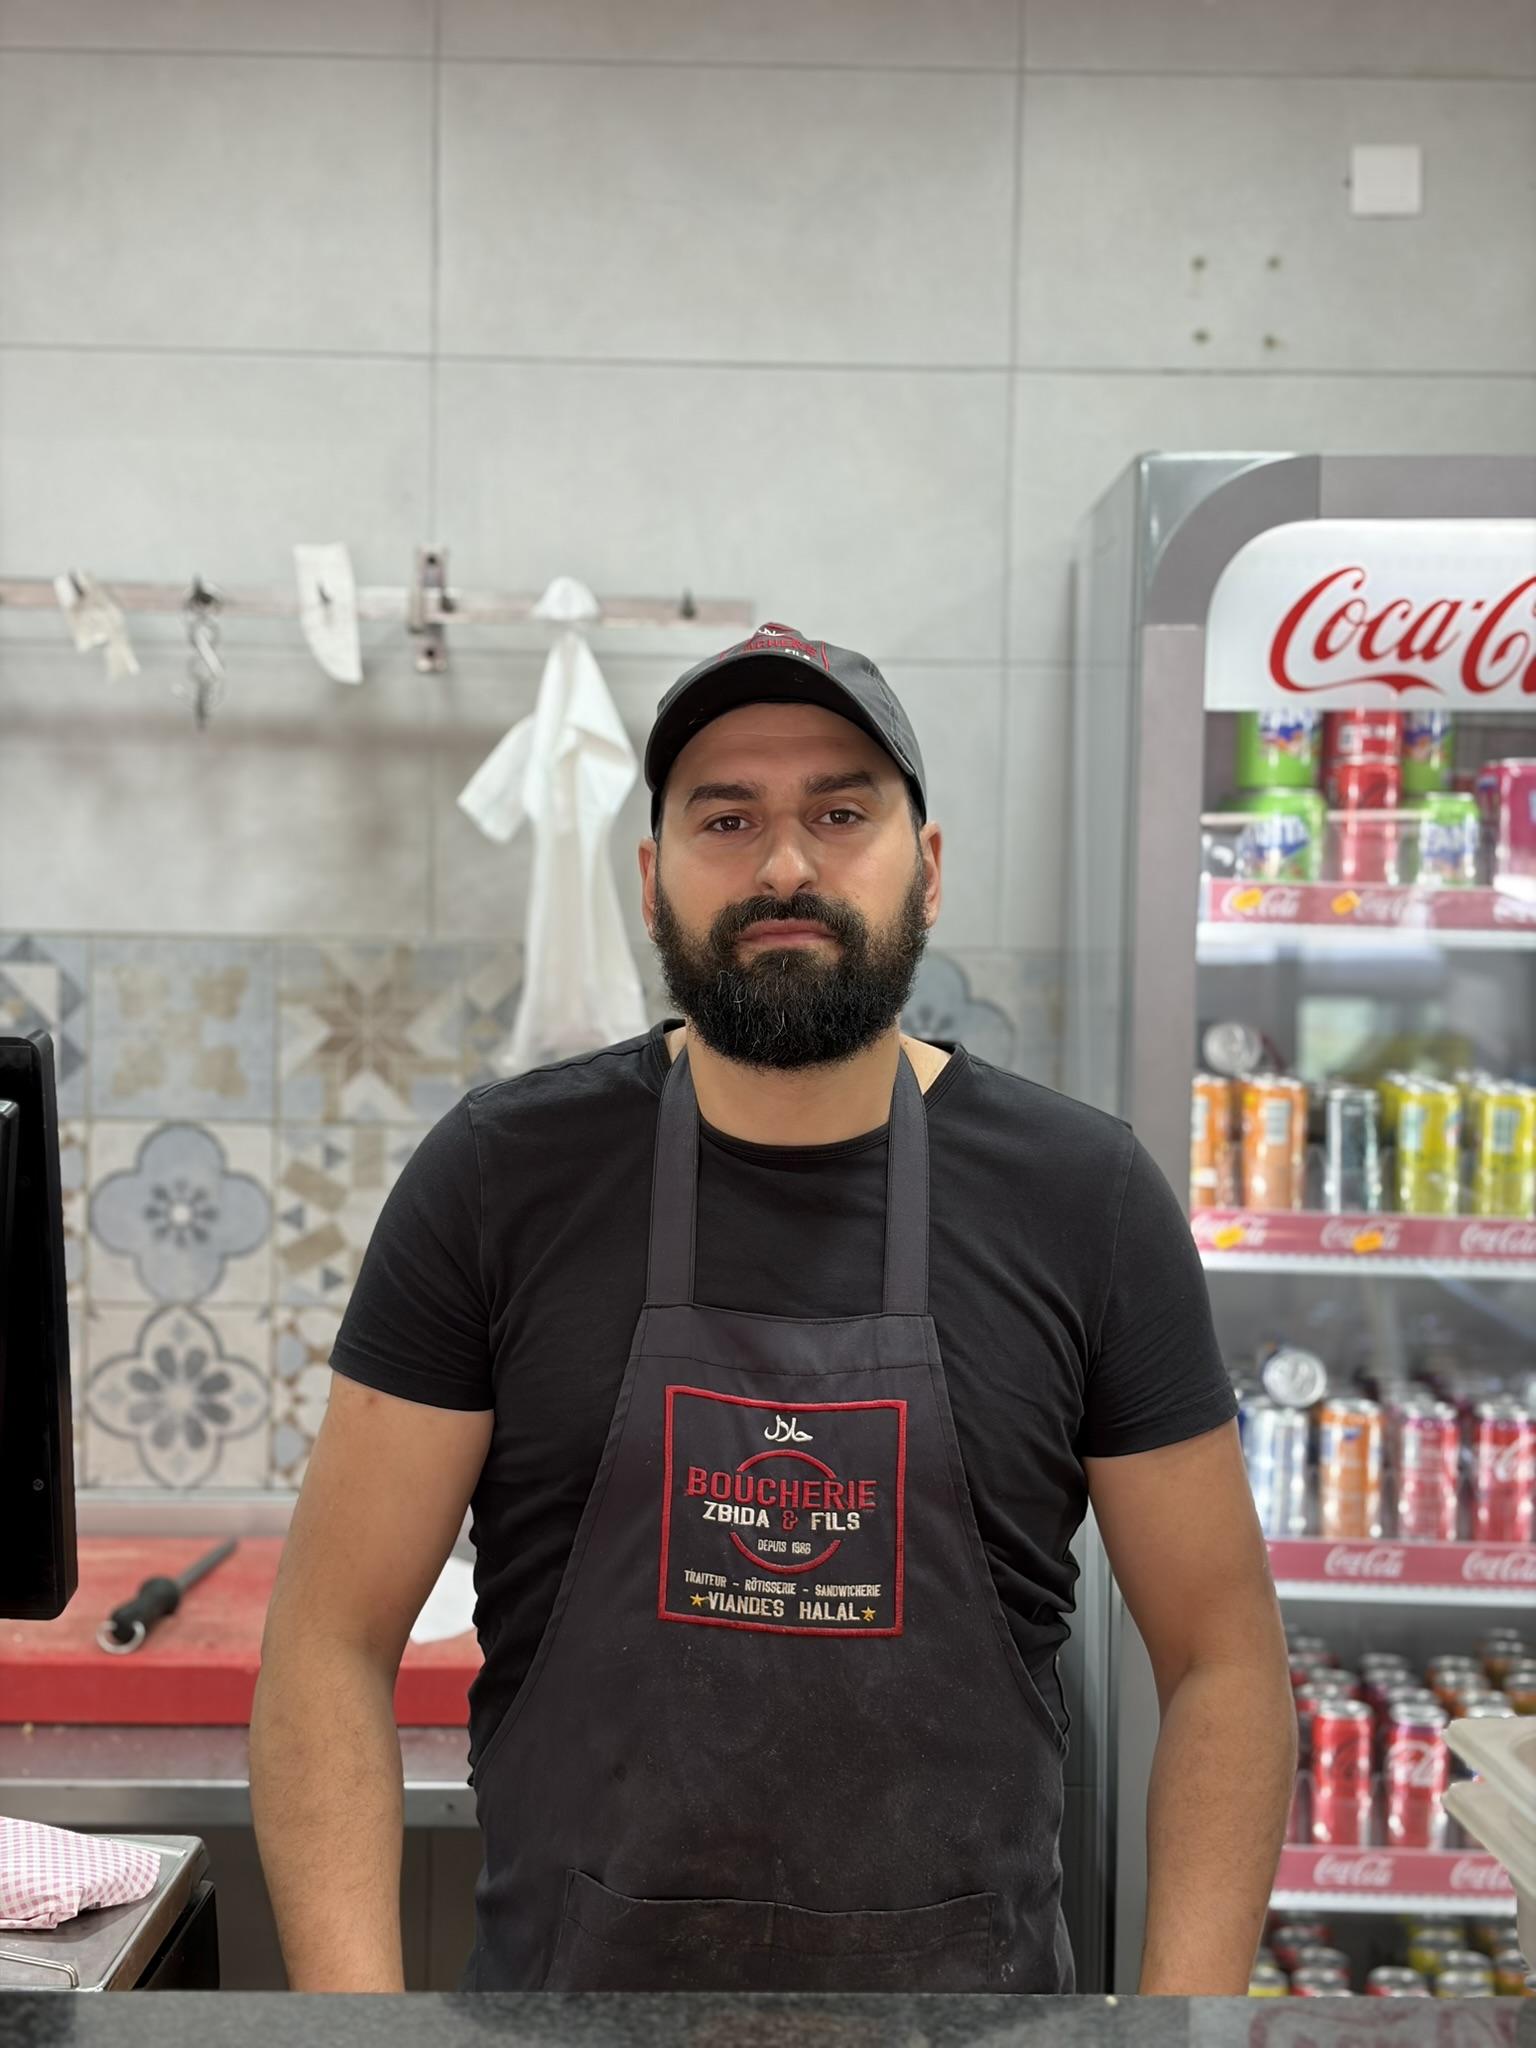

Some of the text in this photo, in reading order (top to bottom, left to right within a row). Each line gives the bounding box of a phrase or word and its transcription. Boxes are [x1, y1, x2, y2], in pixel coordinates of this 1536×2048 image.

[1269, 566, 1536, 694] Coca-C
[764, 1414, 814, 1442] حلال
[686, 1466, 878, 1511] BOUCHERIE
[702, 1500, 860, 1532] ZBIDA & FILS
[757, 1539, 787, 1553] DEPUIS
[684, 1569, 727, 1588] TRAITEUR
[814, 1584, 882, 1598] SANDWICHERIE
[707, 1591, 860, 1621] VIANDES HALAL
